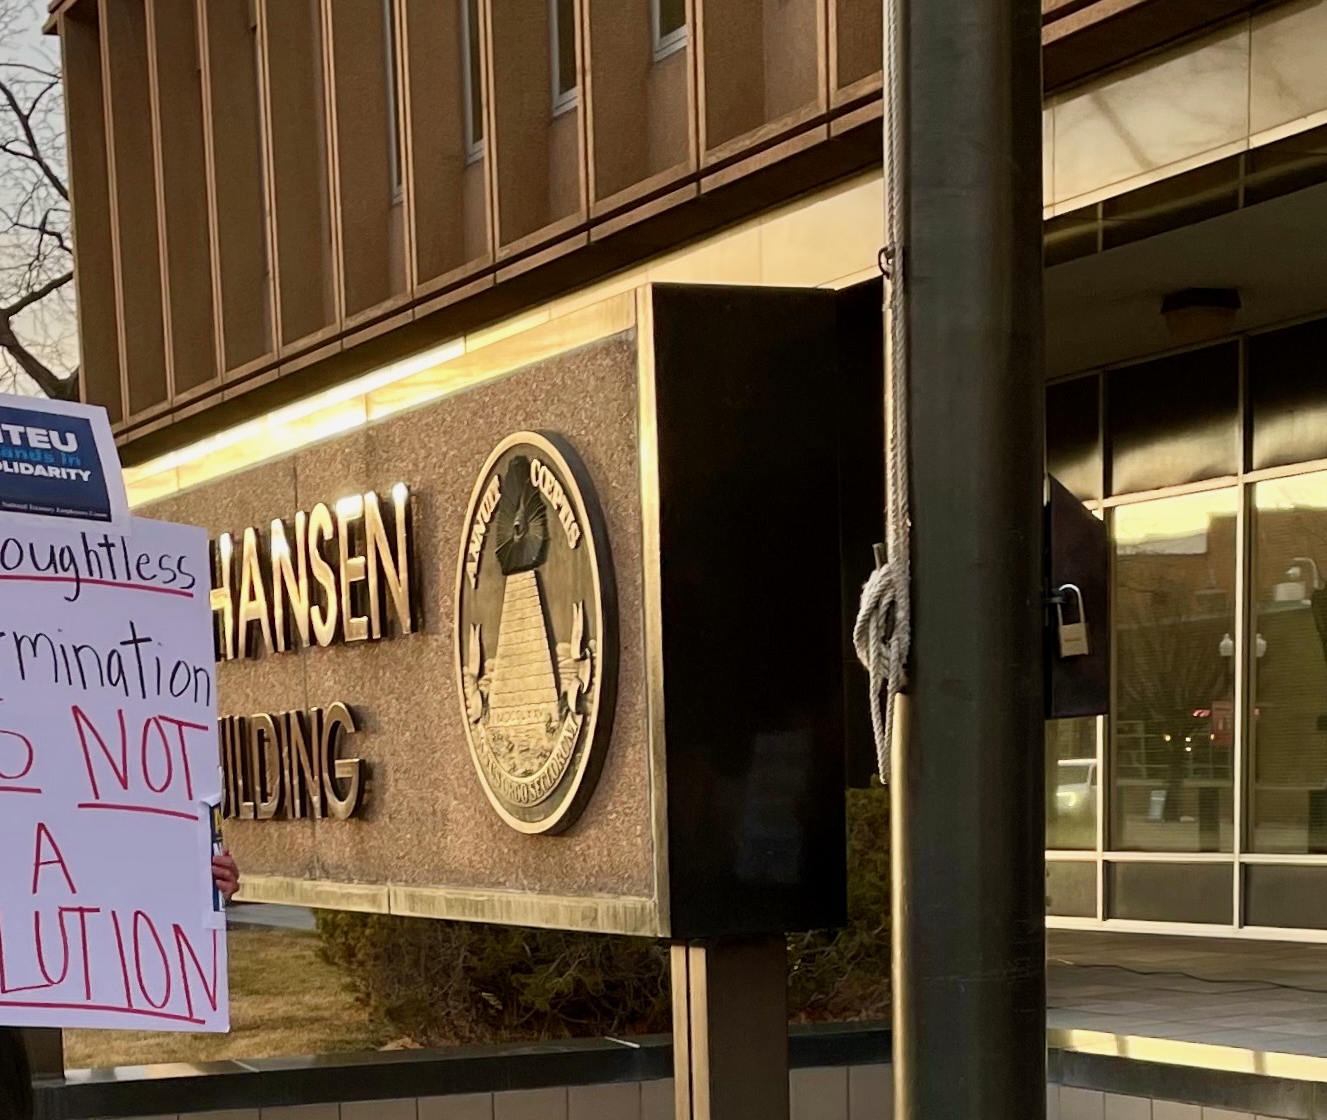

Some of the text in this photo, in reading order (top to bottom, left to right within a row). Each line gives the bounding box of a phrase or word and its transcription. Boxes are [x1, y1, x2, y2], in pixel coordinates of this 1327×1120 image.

[61, 451, 81, 467] in
[210, 482, 414, 660] HANSEN
[72, 705, 209, 800] NOT
[32, 822, 76, 894] A
